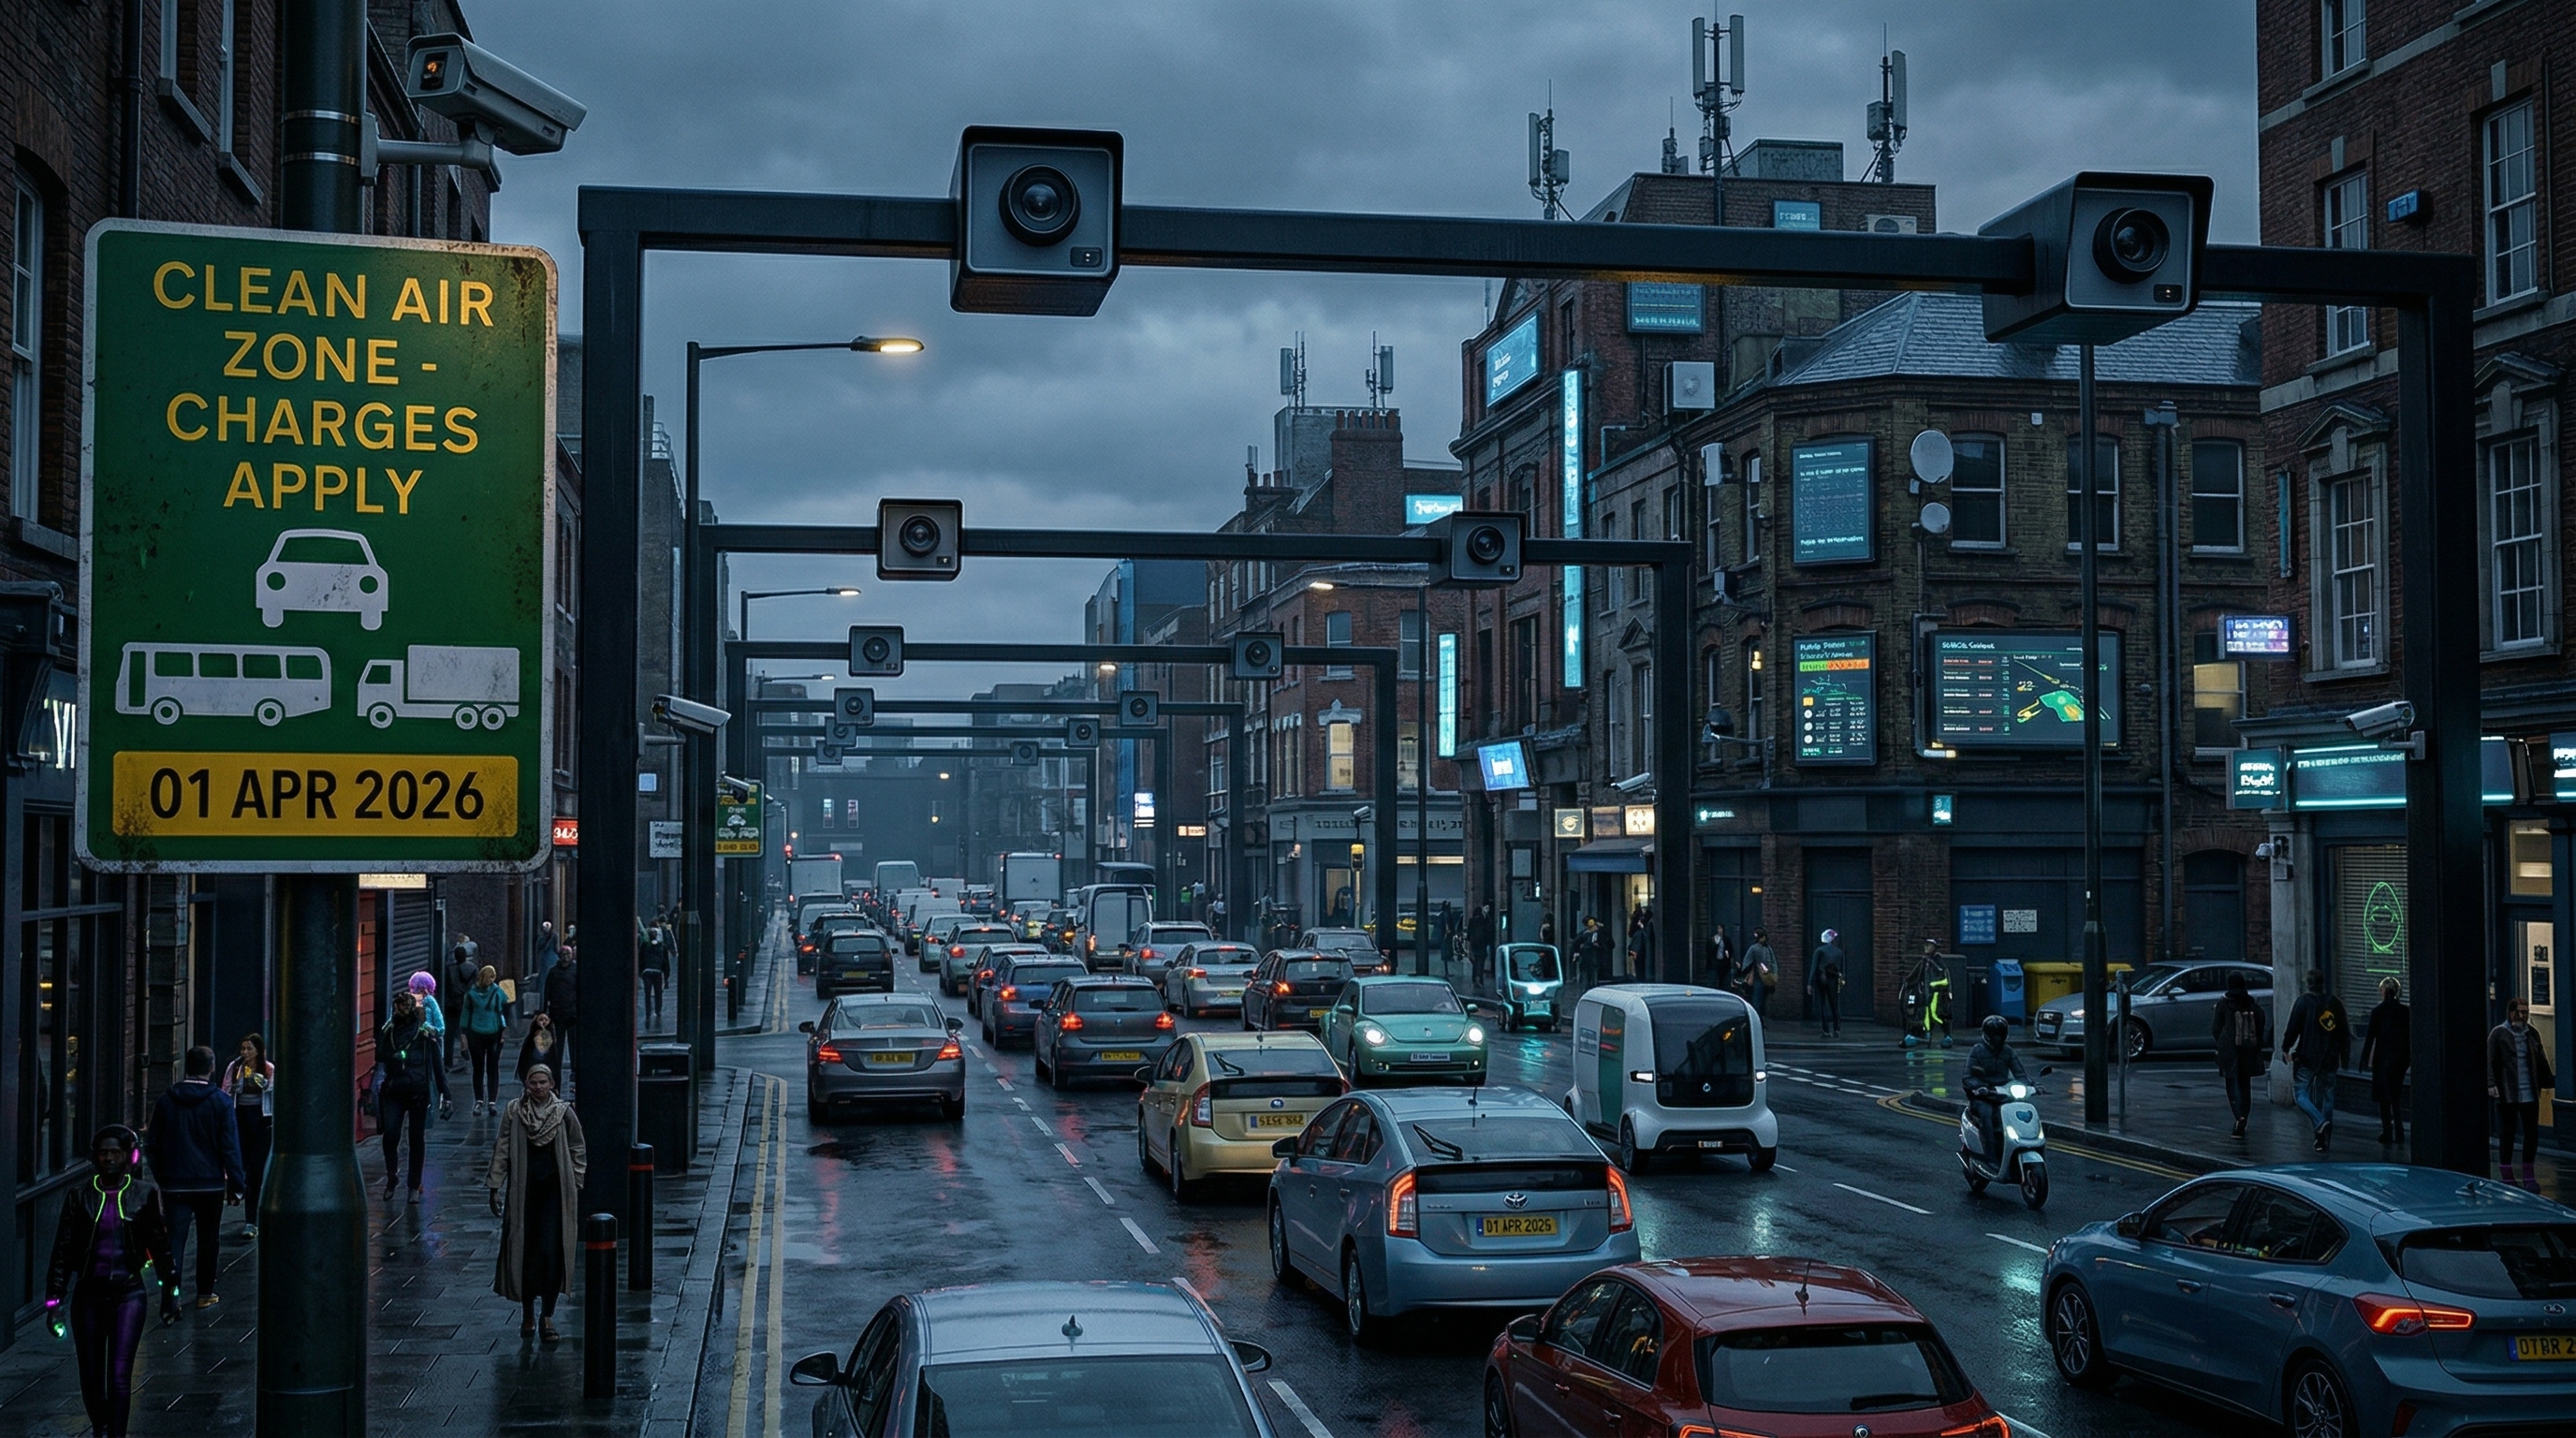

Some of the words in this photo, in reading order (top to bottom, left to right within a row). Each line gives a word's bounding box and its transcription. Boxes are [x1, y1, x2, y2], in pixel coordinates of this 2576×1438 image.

[154, 261, 366, 319] CLEAN
[390, 277, 495, 327] AIR
[223, 331, 400, 386] ZONE
[166, 393, 479, 454] CHARGES
[223, 462, 423, 514] APPLY
[150, 767, 210, 819] 01
[231, 769, 338, 819] APR
[355, 770, 485, 820] 2026
[1502, 1219, 1522, 1232] APR
